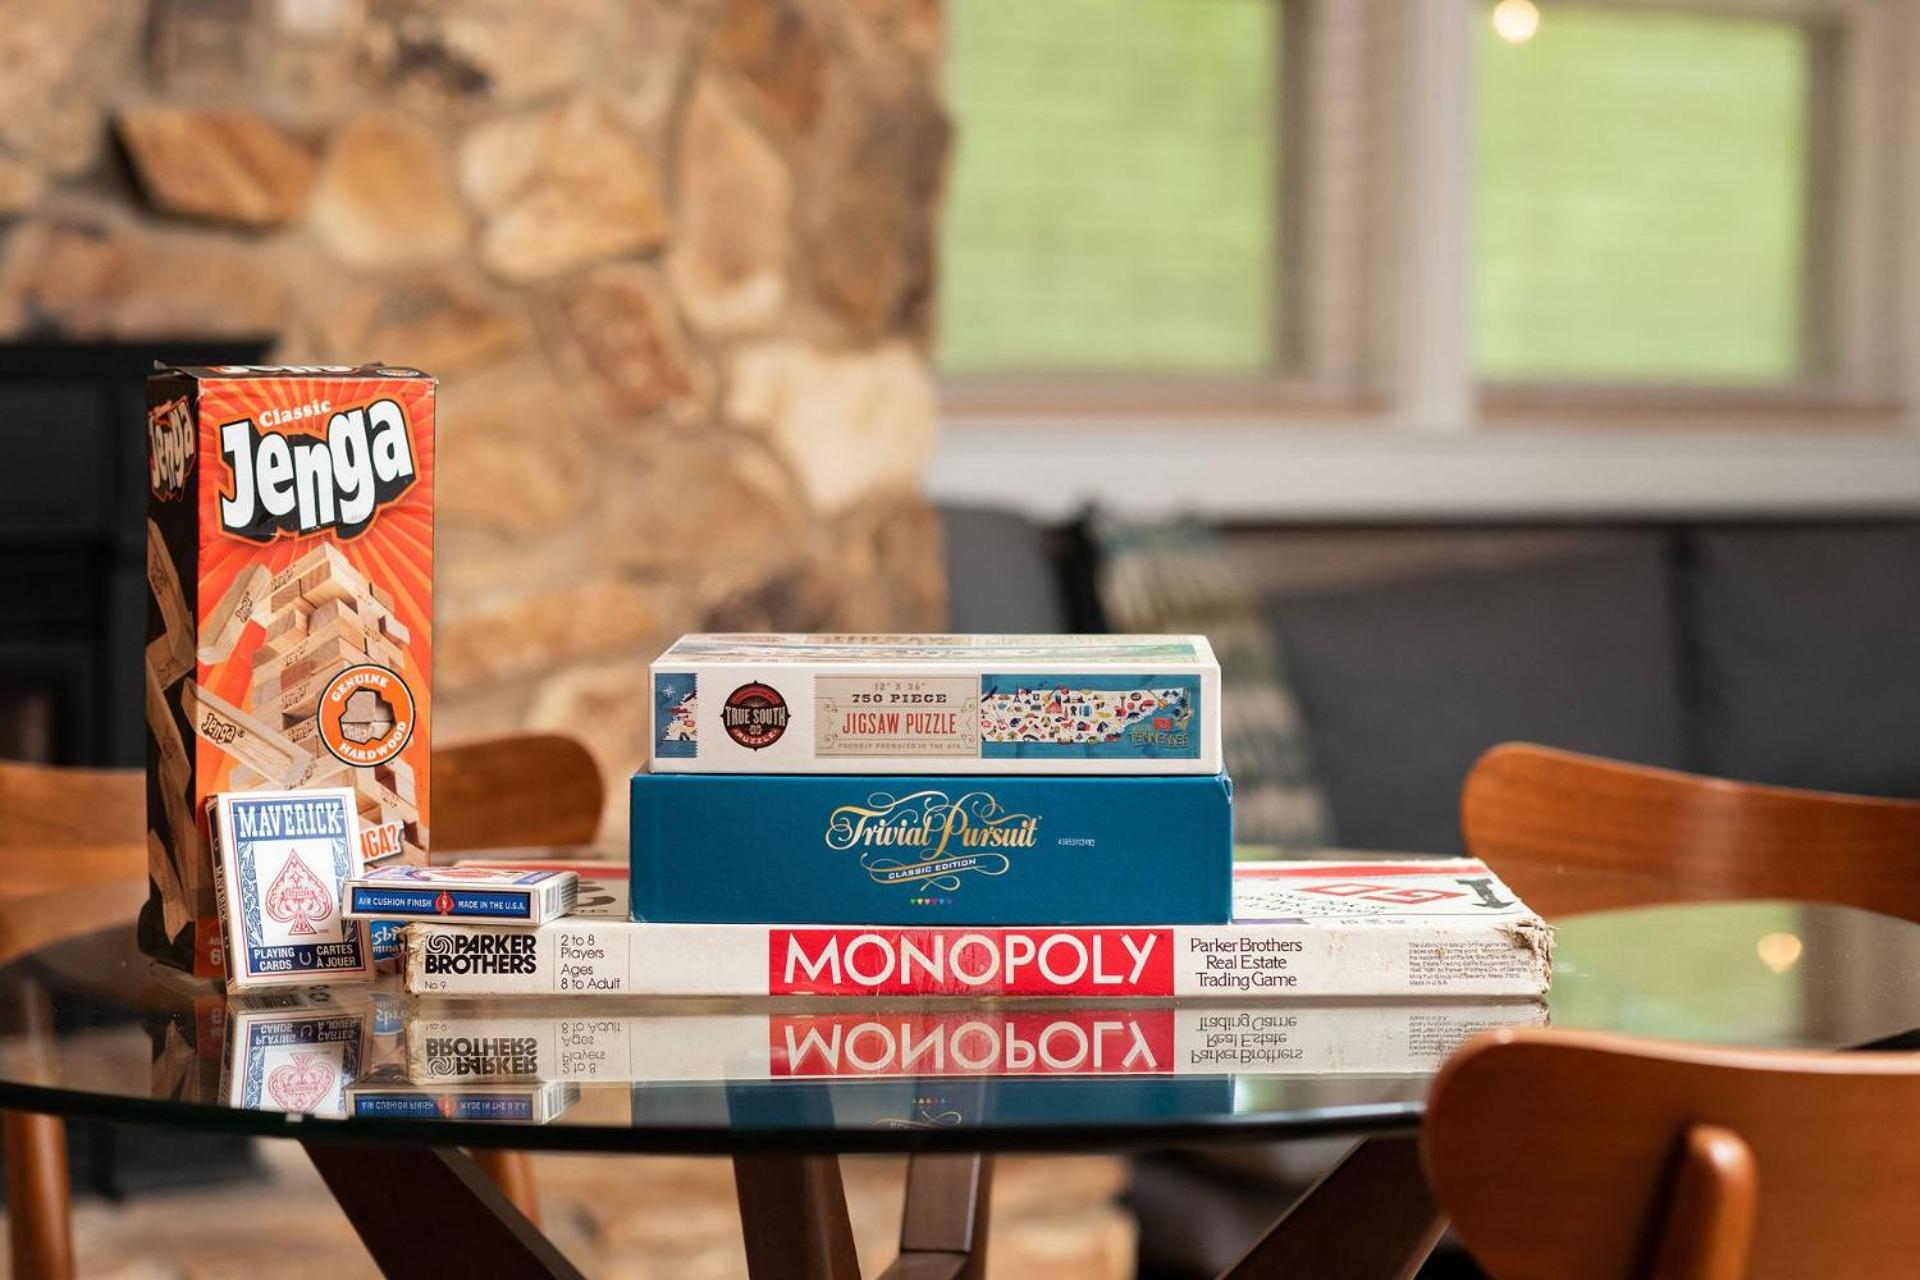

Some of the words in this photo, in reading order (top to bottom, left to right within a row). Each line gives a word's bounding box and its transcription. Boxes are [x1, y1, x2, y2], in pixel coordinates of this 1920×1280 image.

[259, 399, 332, 428] Classic
[220, 398, 414, 537] Jenga
[331, 674, 388, 701] GENUINE
[851, 693, 883, 704] 750
[890, 693, 947, 704] PIECE
[725, 706, 750, 727] TRUE
[753, 706, 786, 727] SOUTH
[842, 713, 900, 734] JIGSAW
[905, 713, 958, 734] PUZZLE
[201, 711, 236, 744] Jenga
[338, 721, 406, 759] HARDWOOD
[238, 802, 344, 838] MAVERICK
[826, 795, 935, 850] Trivial
[925, 793, 1043, 860] Pursuit
[888, 866, 932, 880] CLASSIC
[935, 858, 977, 872] EDITION
[358, 897, 372, 906] AIR
[373, 897, 406, 908] CUSHION
[407, 898, 432, 908] FINISH
[458, 899, 478, 909] MADE
[480, 900, 487, 909] IN
[488, 900, 504, 910] THE
[454, 934, 537, 954] PARKER
[561, 934, 569, 946] 2
[571, 934, 584, 946] to
[587, 934, 595, 946] 8
[1190, 938, 1238, 952] Parker
[1239, 938, 1303, 952] Brothers
[254, 947, 296, 960] PLAYING
[316, 945, 354, 956] CARTES
[561, 947, 605, 960] Players
[783, 932, 1157, 985] MONOPOLY
[259, 959, 293, 972] CARDS
[326, 955, 356, 968] JOUER
[424, 954, 537, 974] BROTHERS
[560, 963, 594, 978] Ages
[1206, 955, 1238, 970] Real
[1240, 955, 1288, 970] Estate
[441, 981, 447, 989] 9
[560, 977, 569, 990] 8
[571, 978, 584, 990] to
[587, 977, 621, 990] Adult
[1195, 972, 1251, 990] Trading
[1252, 972, 1297, 987] Game
